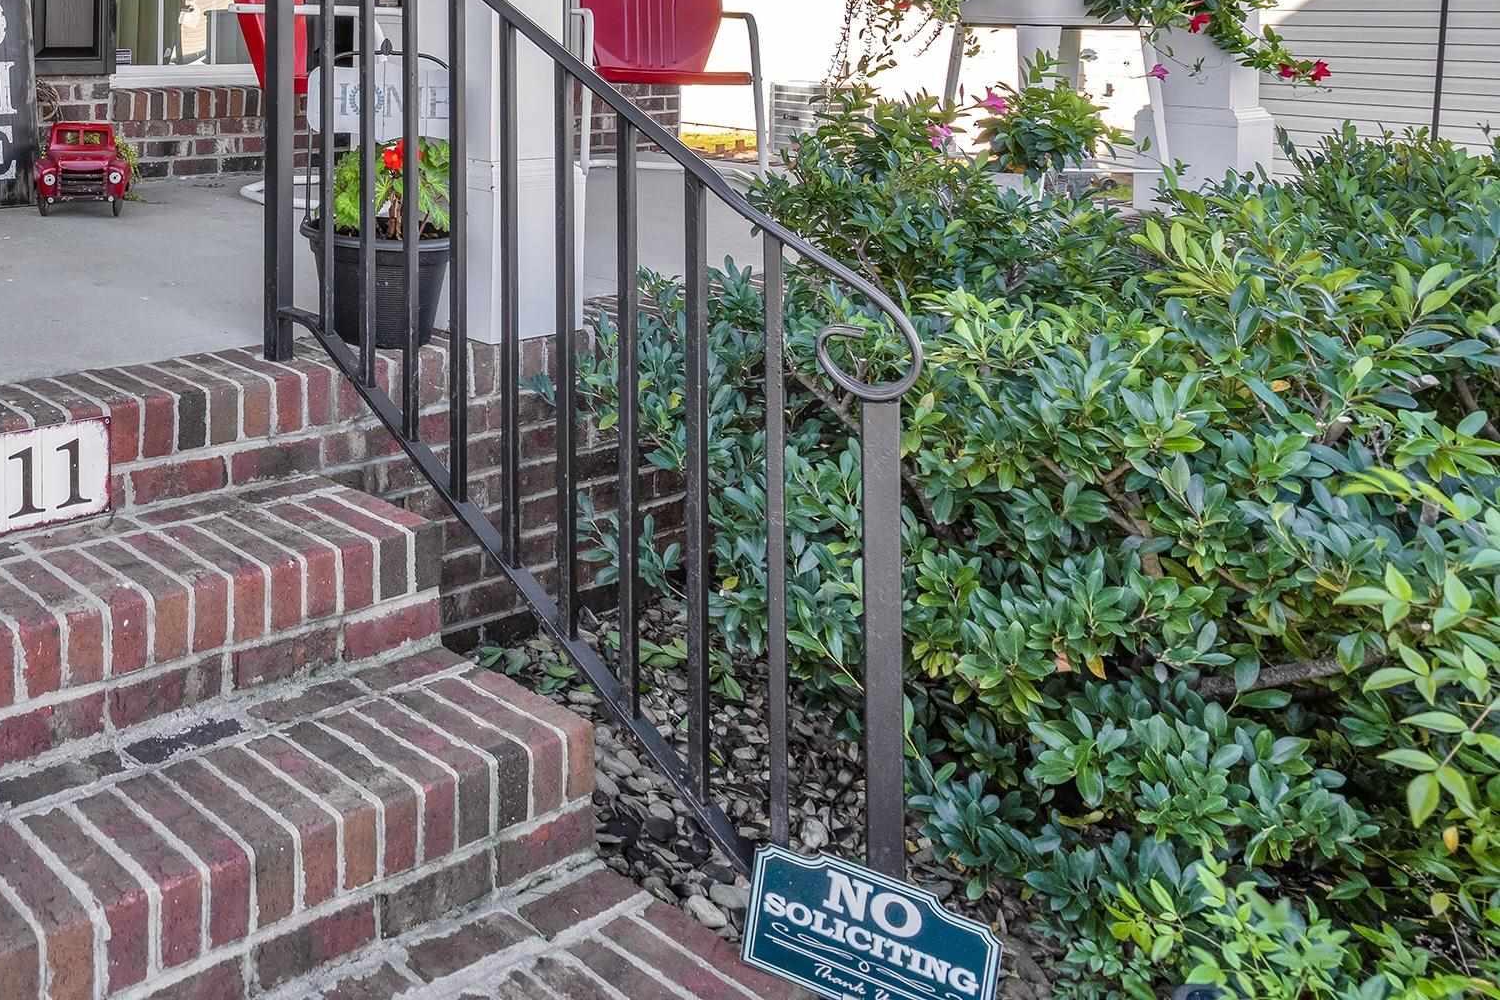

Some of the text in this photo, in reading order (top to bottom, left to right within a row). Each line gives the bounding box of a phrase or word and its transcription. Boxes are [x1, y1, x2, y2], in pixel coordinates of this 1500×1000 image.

[823, 869, 922, 938] NO
[764, 892, 979, 996] SOLICITING
[814, 963, 866, 995] Thank
